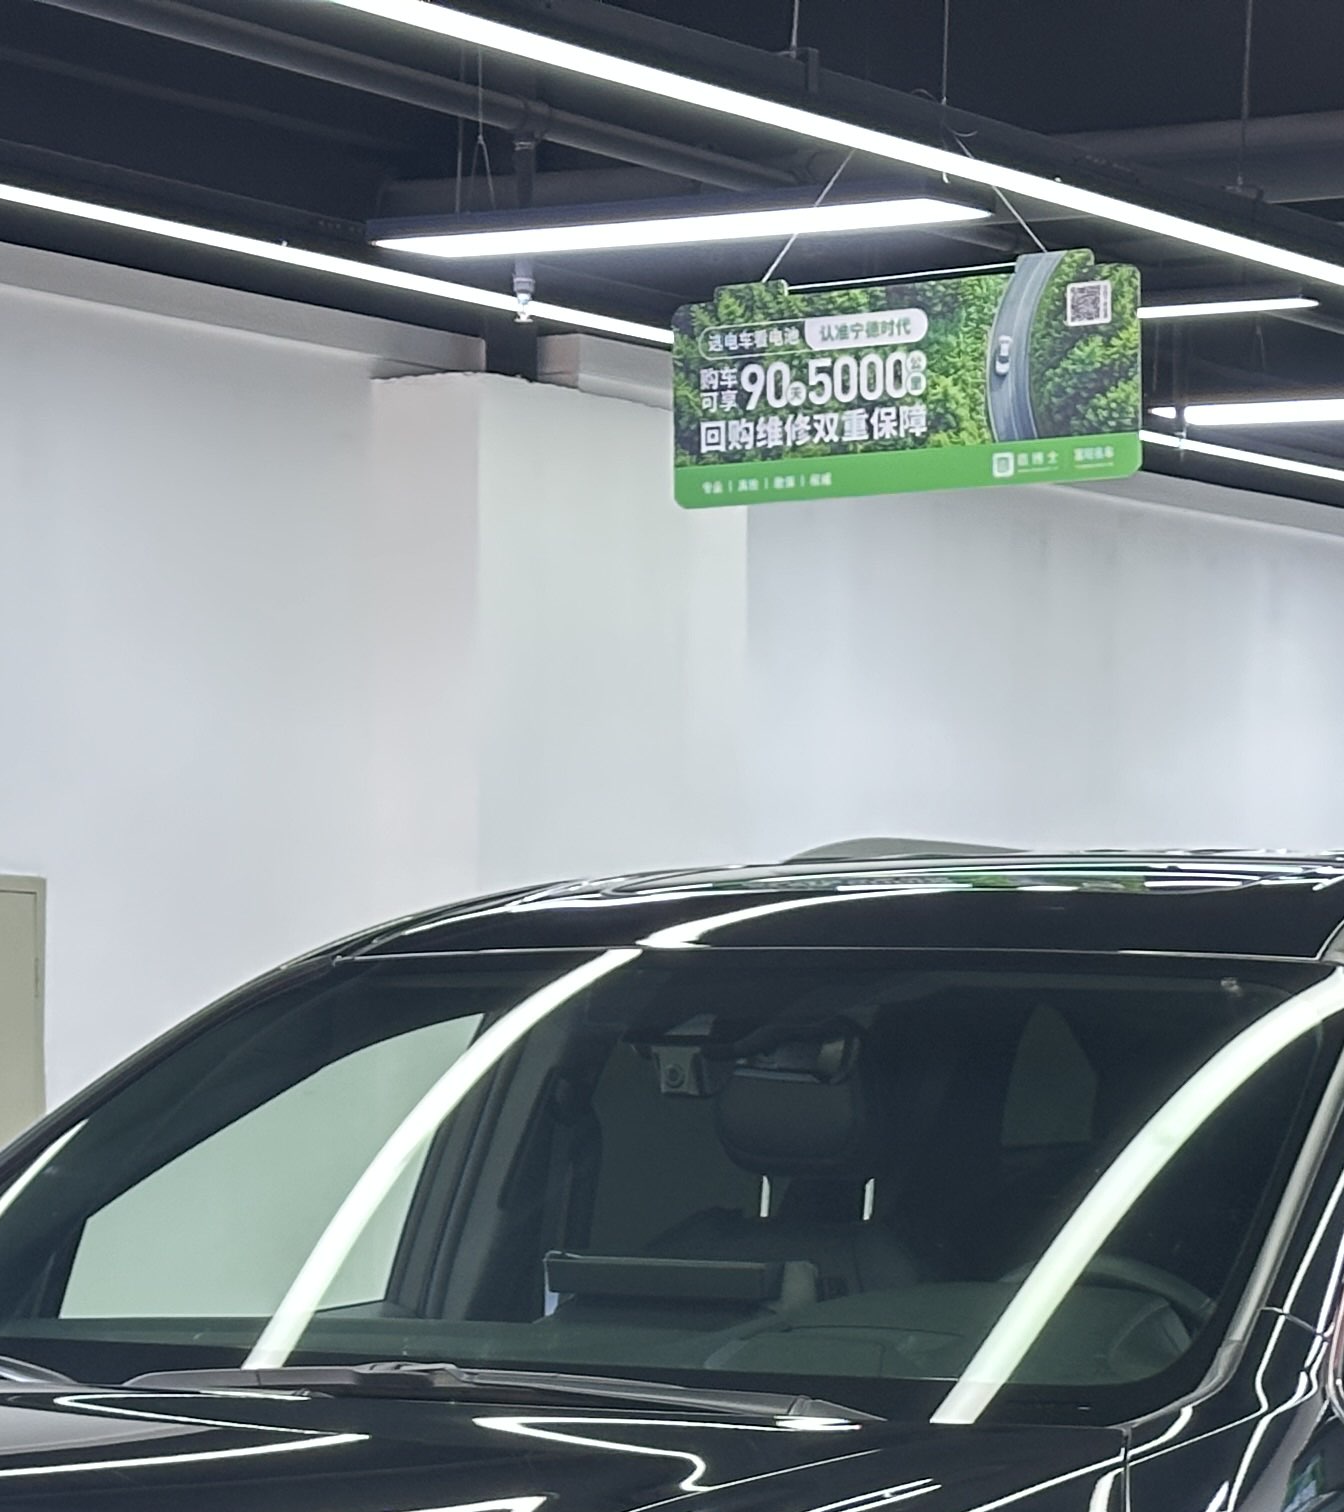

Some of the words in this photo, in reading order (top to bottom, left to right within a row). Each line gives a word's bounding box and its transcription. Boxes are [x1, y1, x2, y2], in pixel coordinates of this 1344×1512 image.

[819, 316, 912, 342] 认准宁德时代
[699, 366, 738, 391] 购车
[700, 389, 739, 413] 可享
[699, 403, 928, 454] 回购维修双重保障
